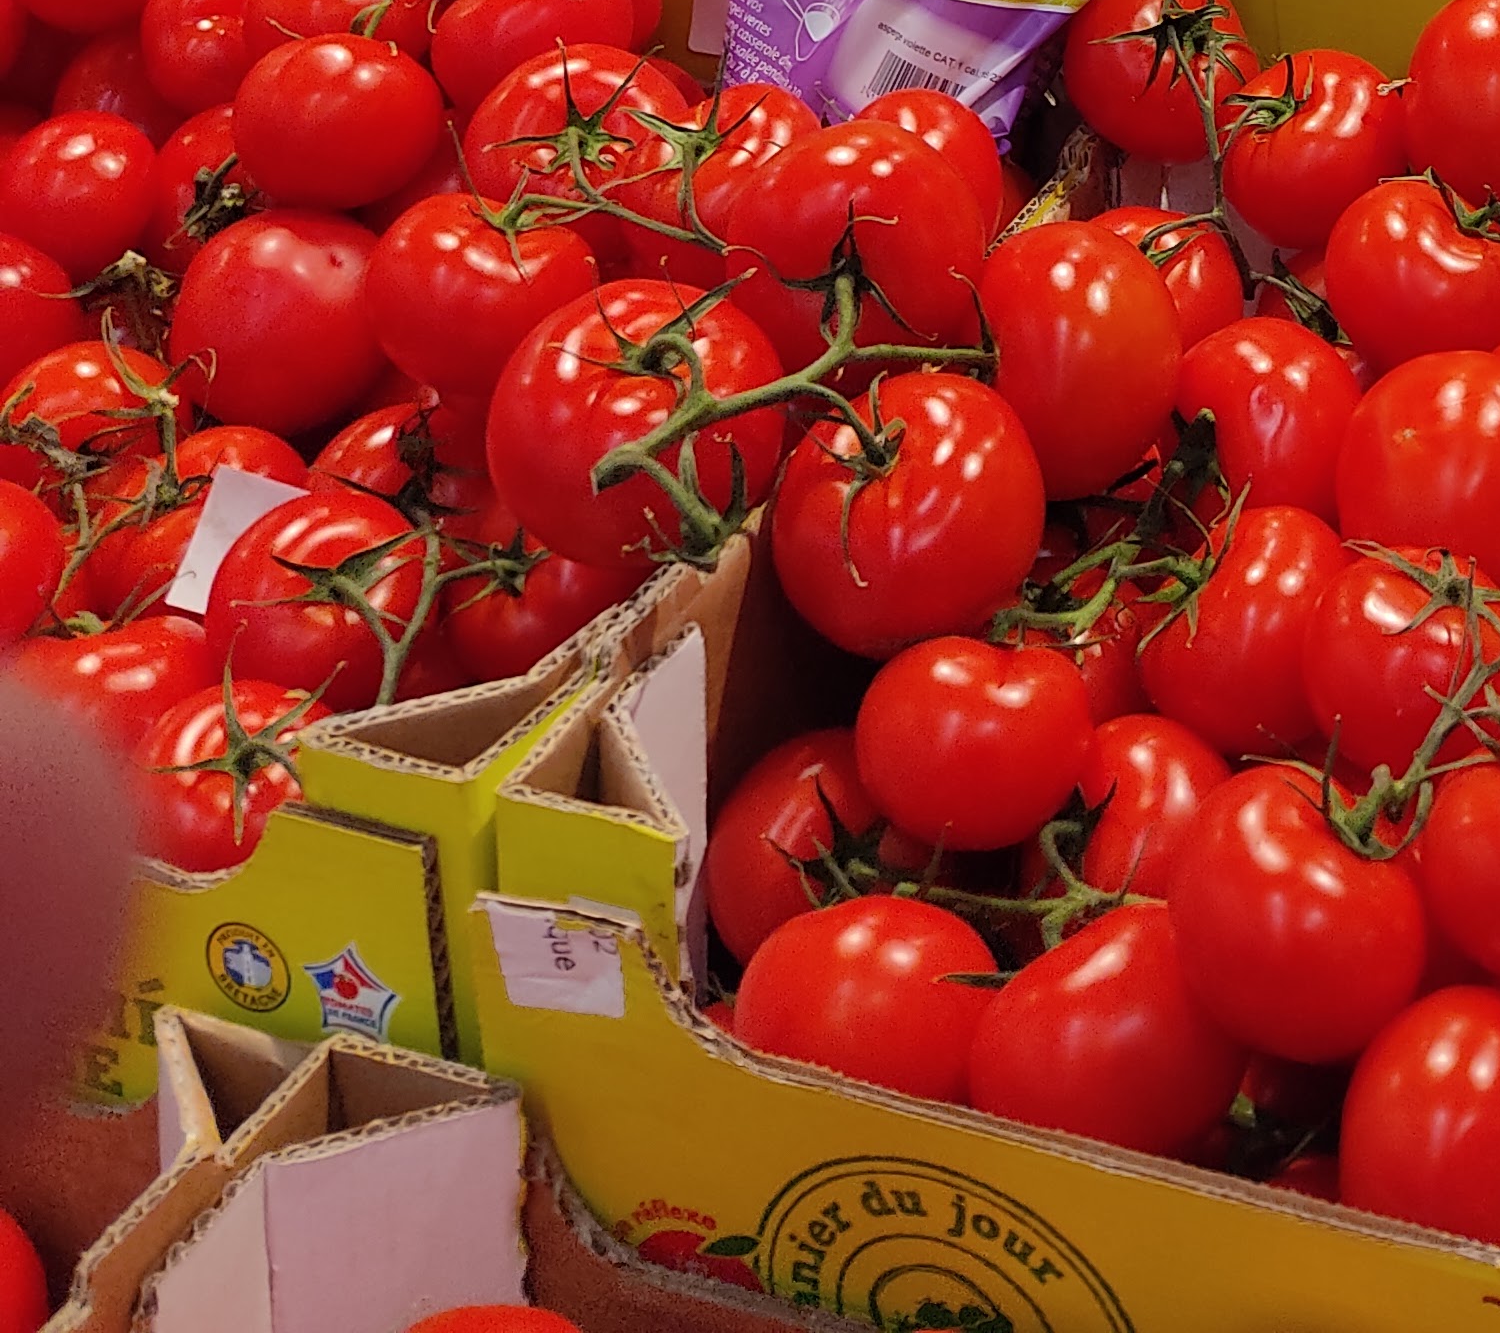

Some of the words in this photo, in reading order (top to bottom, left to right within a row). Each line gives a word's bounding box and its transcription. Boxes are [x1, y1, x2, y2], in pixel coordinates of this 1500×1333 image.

[741, 13, 772, 37] vertes
[732, 42, 761, 66] salée
[734, 27, 781, 61] casserole
[789, 1199, 853, 1306] nier
[860, 1181, 928, 1218] du
[947, 1194, 1066, 1285] jour
